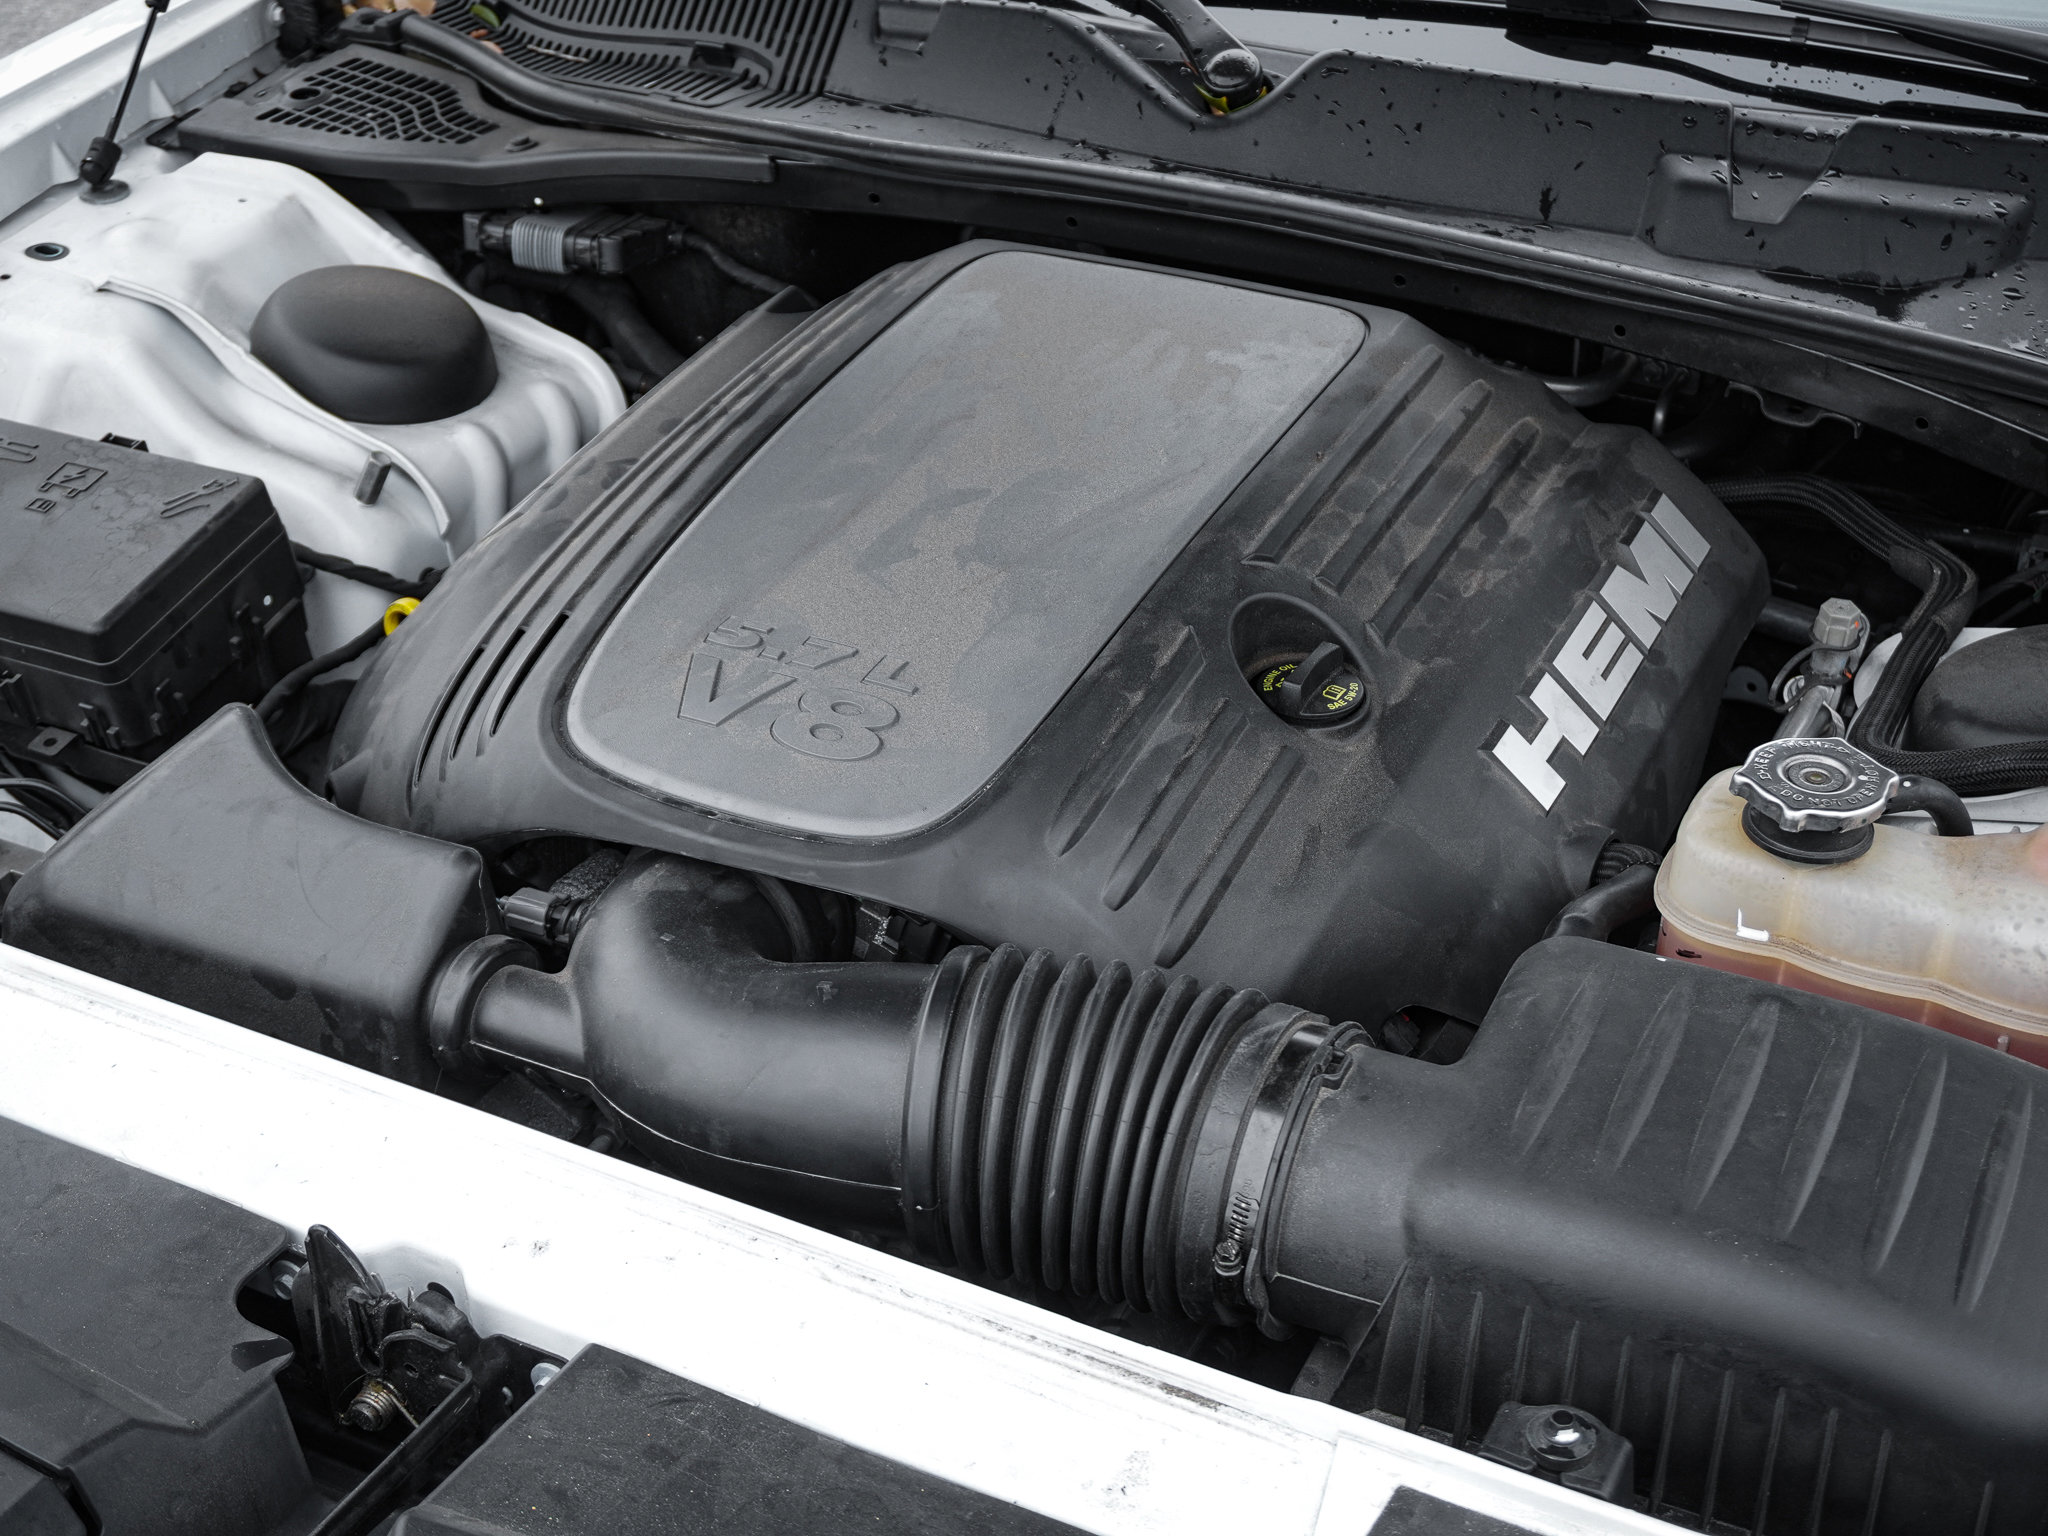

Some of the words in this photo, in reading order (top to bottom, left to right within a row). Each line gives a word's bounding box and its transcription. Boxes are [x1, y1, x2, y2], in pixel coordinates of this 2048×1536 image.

[702, 615, 920, 696] 5.7L
[1491, 492, 1712, 812] HEMI
[1263, 669, 1281, 691] ENGINE
[1279, 663, 1297, 671] OIL
[676, 651, 901, 762] V8
[1327, 699, 1348, 710] SAE
[1344, 682, 1359, 702] 5W-20
[1754, 746, 1777, 770] KEEP
[1780, 789, 1804, 801] DO
[1808, 796, 1843, 807] NOT
